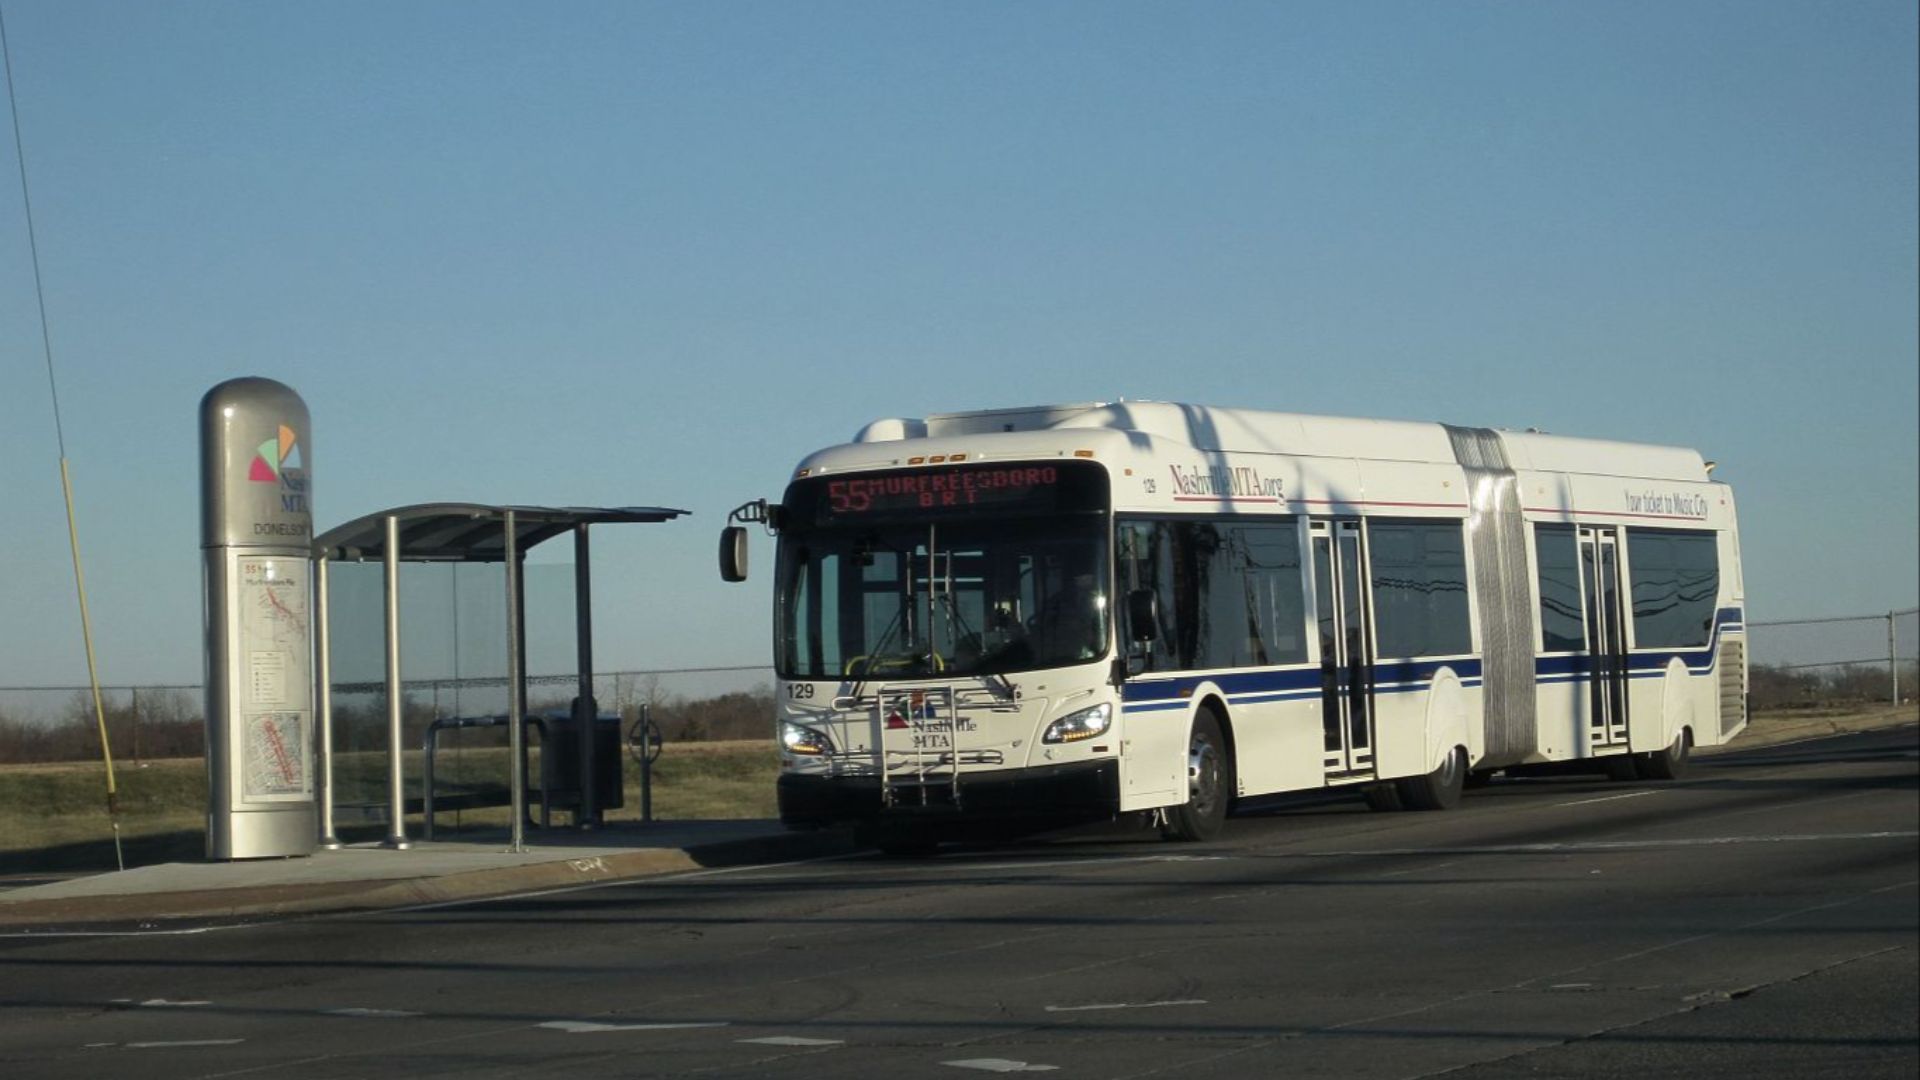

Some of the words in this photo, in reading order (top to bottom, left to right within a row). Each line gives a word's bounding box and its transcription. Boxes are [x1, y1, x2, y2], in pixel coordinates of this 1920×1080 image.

[830, 480, 870, 512] 55
[870, 467, 1058, 496] MURFREESBORO
[1624, 489, 1641, 512] Your
[1665, 493, 1672, 514] to
[1673, 492, 1694, 516] Music
[1695, 493, 1708, 519] City
[787, 684, 815, 699] 129
